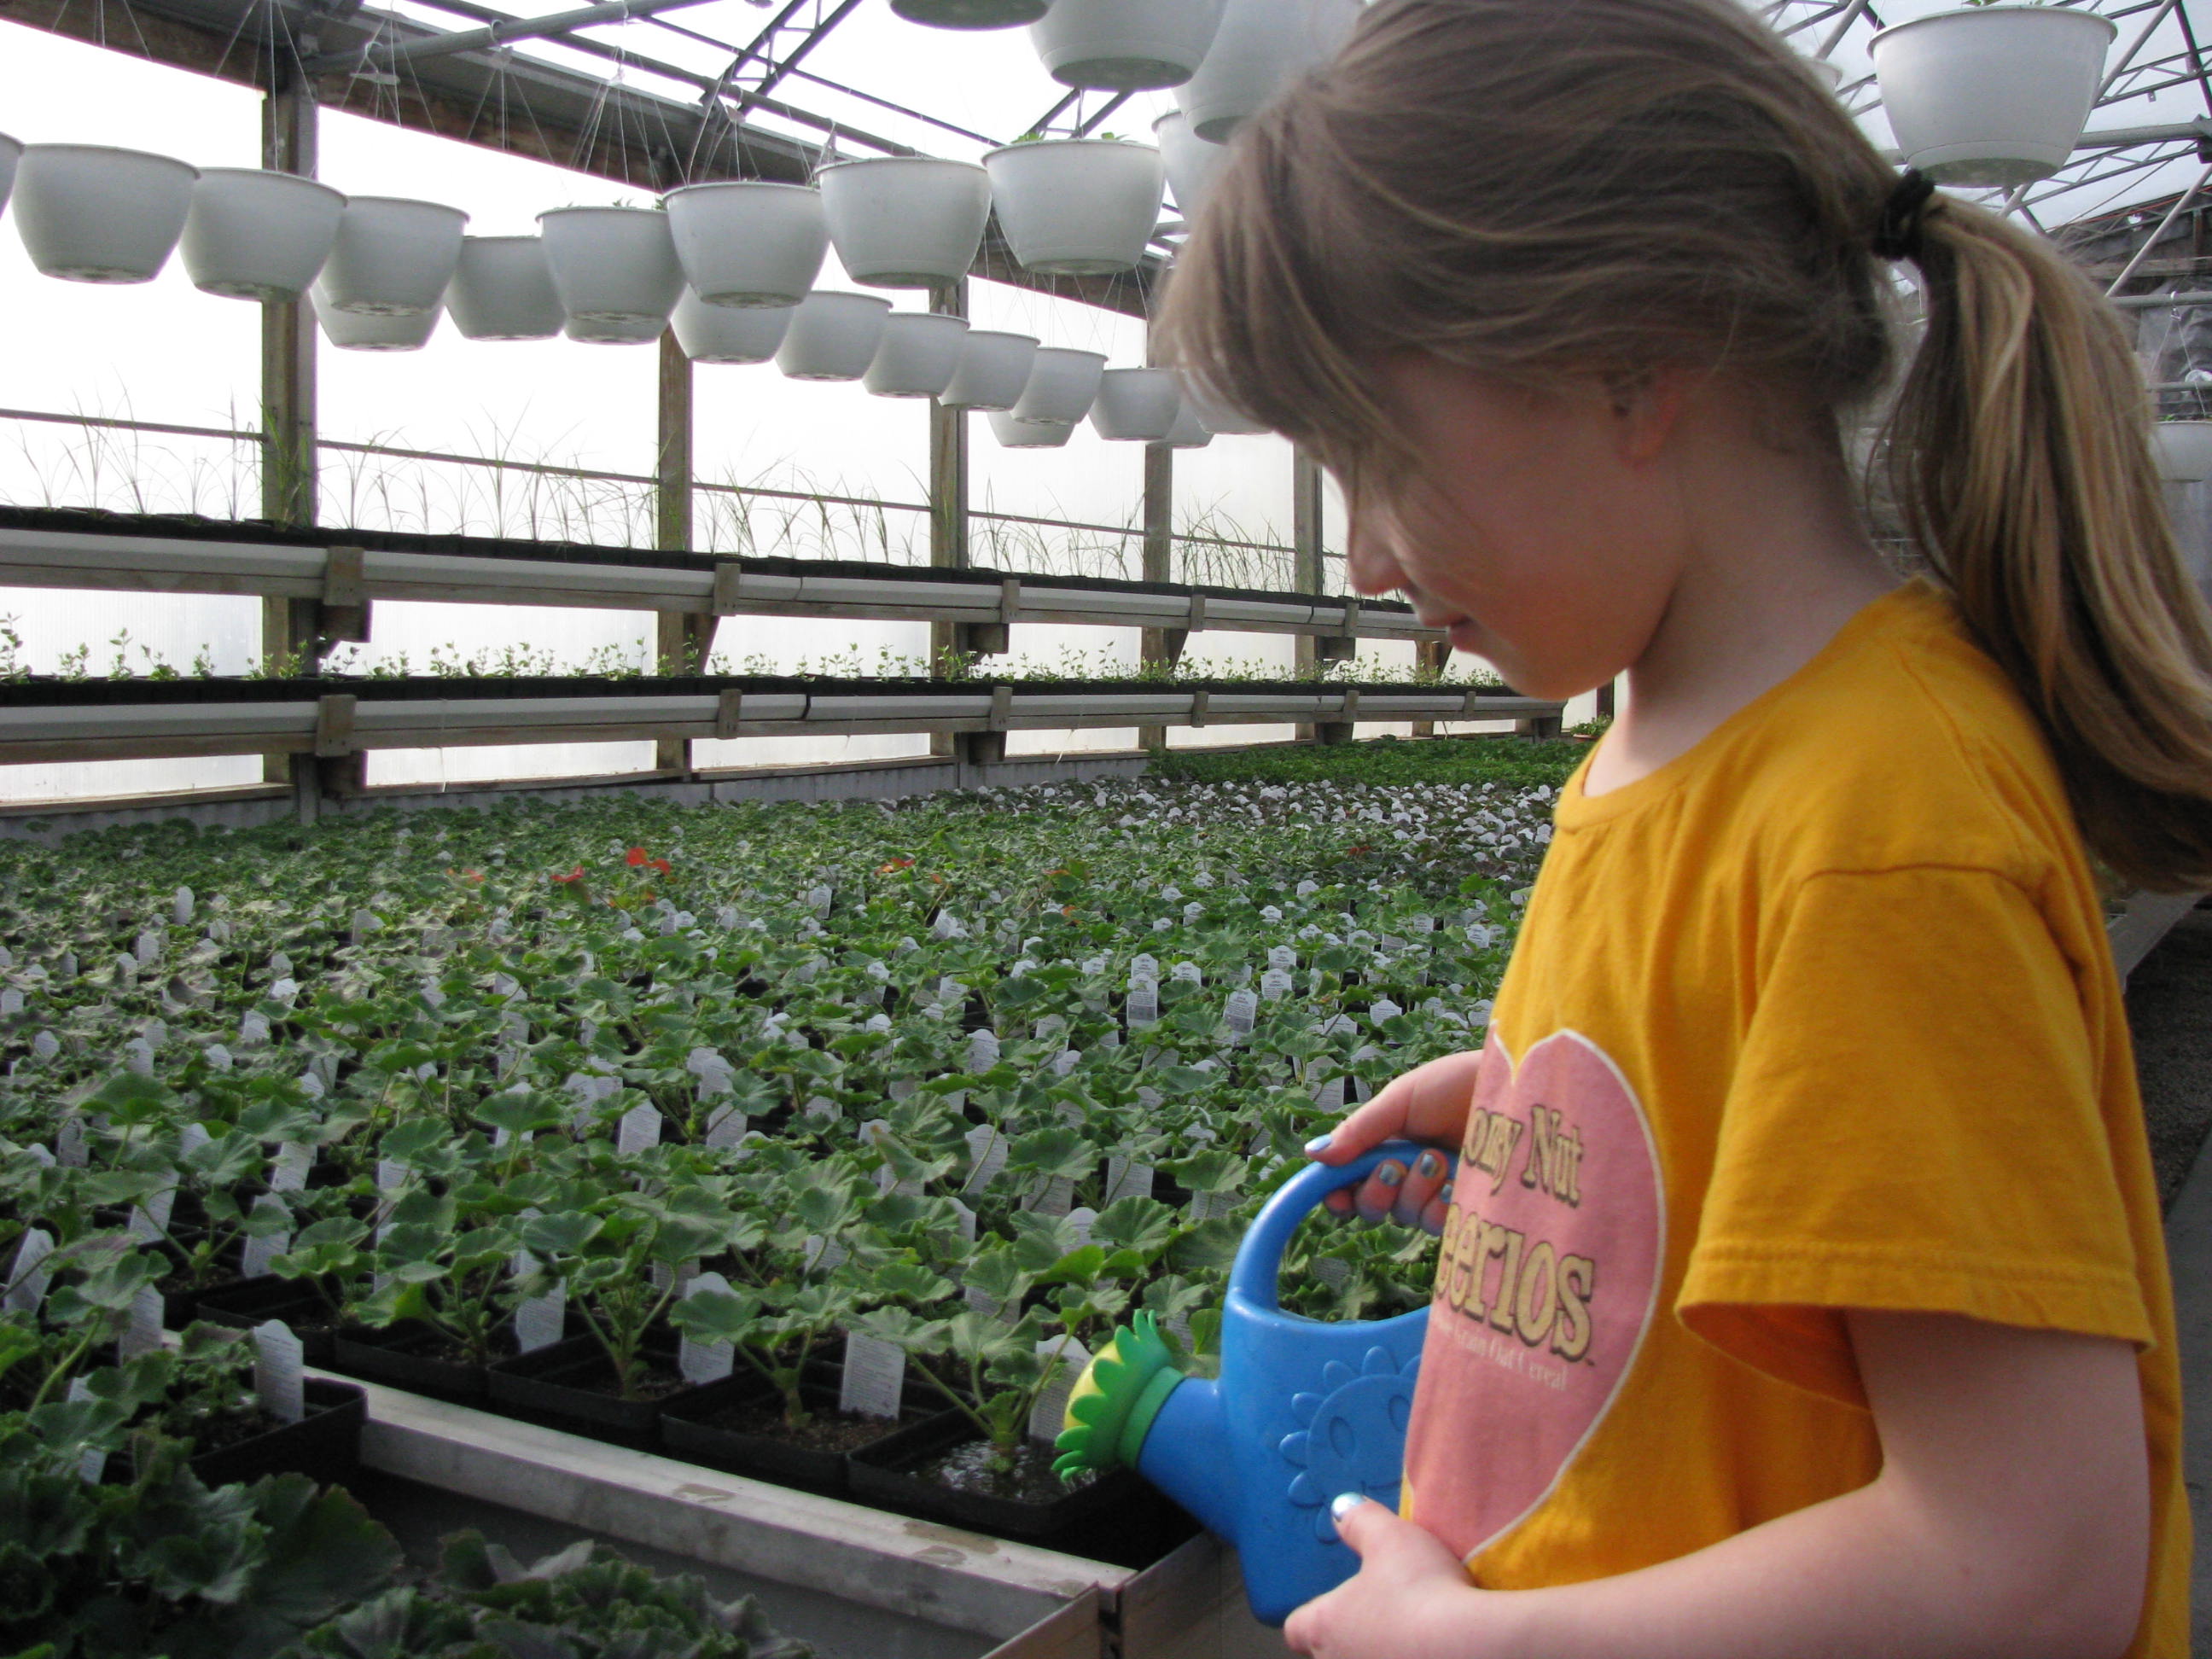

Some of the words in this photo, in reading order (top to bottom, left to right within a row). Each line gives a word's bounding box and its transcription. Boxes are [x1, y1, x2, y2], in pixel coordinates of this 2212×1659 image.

[1464, 1107, 1523, 1196] oney
[1521, 1104, 1583, 1208] Nut
[1435, 1202, 1595, 1362] eerios
